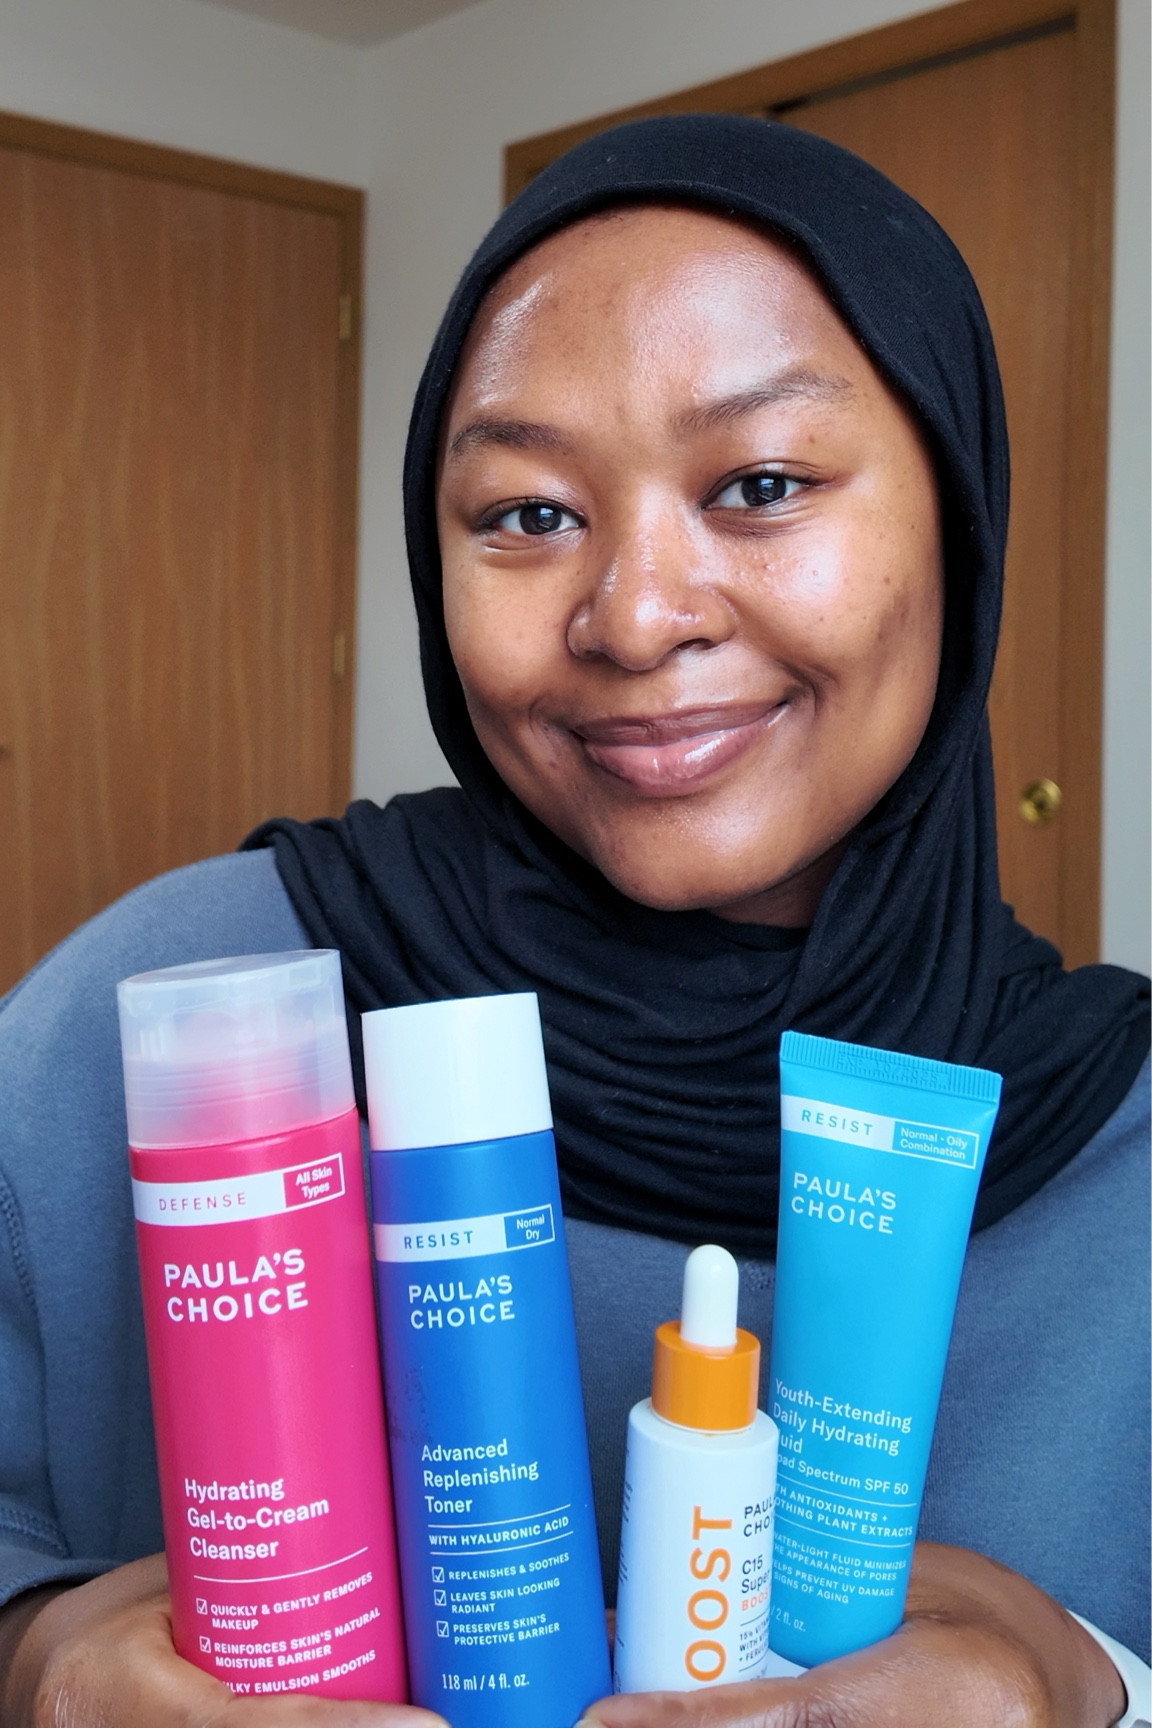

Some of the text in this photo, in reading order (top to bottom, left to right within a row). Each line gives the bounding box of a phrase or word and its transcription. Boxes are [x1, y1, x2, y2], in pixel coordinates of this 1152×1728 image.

[801, 1108, 873, 1136] RESIST
[900, 1127, 967, 1149] Normal Oily
[900, 1139, 966, 1160] Combination
[295, 1166, 332, 1186] All Skin
[158, 1192, 246, 1211] DEFENSE
[301, 1181, 330, 1199] Types
[793, 1172, 897, 1210] PAULA'S
[516, 1214, 545, 1230] Normal
[791, 1196, 894, 1234] CHOICE
[403, 1230, 474, 1249] RESIST
[525, 1228, 540, 1241] Dry
[164, 1248, 305, 1289] PAULA'S
[167, 1281, 308, 1323] CHOICE
[408, 1274, 512, 1304] PAULA'S
[410, 1300, 515, 1330] CHOICE
[775, 1378, 912, 1434] Youth-Extending
[773, 1402, 900, 1456] Daily Hydrating
[778, 1428, 803, 1454] uid
[421, 1438, 508, 1462] Advanced
[423, 1461, 539, 1491] Replenishing
[777, 1454, 909, 1496] oad Spectrum SPF 50
[184, 1477, 285, 1503] Hydrating
[776, 1484, 787, 1496] TH
[790, 1489, 878, 1522] ANTIOXIDANTS
[187, 1499, 330, 1531] Gel-to-Cream
[425, 1495, 473, 1514] Toner
[744, 1496, 774, 1519] PAUL
[774, 1496, 913, 1538] OTHING PLANT EXTRACTS
[428, 1515, 569, 1546] WITH HYALURONIC ACID
[743, 1512, 773, 1537] CHO
[189, 1536, 279, 1560] Cleanser
[832, 1551, 862, 1567] FLUID
[863, 1558, 906, 1570] MINIMIZES
[448, 1552, 570, 1581] REPLENISHES & SOOTHES
[742, 1554, 763, 1575] C15
[774, 1543, 897, 1581] HE APPEARANCE OF PORES
[450, 1577, 560, 1603] LEAVES SKIN LOOKING
[773, 1560, 895, 1597] ELPS PREVENT UV DAMAGE
[773, 1570, 850, 1604] SIGNS OF AGING
[210, 1572, 373, 1617] QUICKLY & GENTLY REMOVES
[684, 1505, 732, 1682] OOST
[741, 1590, 769, 1611] BOOS
[451, 1603, 496, 1614] RADIANT
[775, 1608, 781, 1621] 2
[211, 1618, 259, 1631] MAKEUP
[214, 1607, 381, 1655] REINFORCES SKIN'S NATURAL
[453, 1613, 547, 1634] PRESERVES SKIN'S
[454, 1622, 560, 1646] PROTECTIVE BARRIER
[215, 1644, 332, 1669] MOISTURE BARRIER
[254, 1673, 320, 1693] EMULSION
[322, 1649, 376, 1681] SMOOTHS
[442, 1673, 461, 1690] 118
[463, 1677, 477, 1691] ml
[488, 1674, 496, 1690] 4
[499, 1673, 511, 1689] fl.
[513, 1673, 530, 1688] oz.
